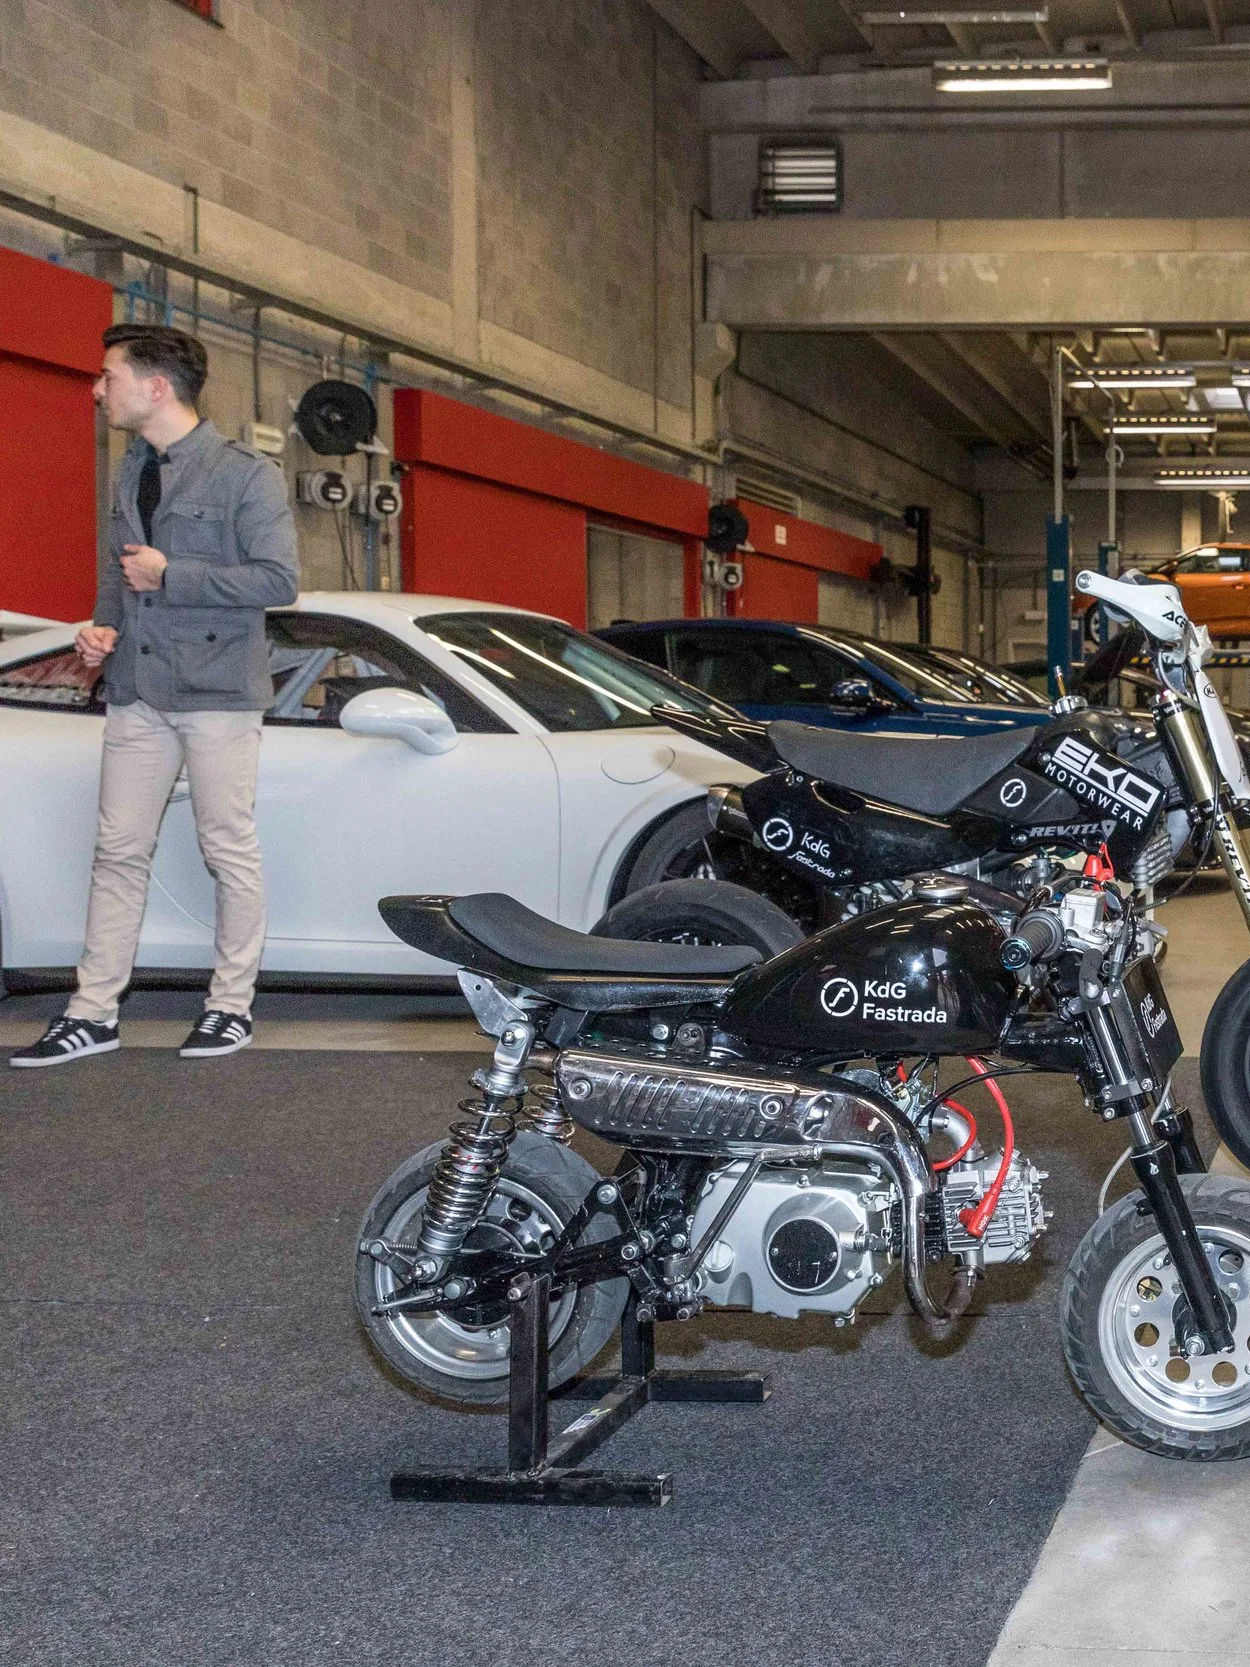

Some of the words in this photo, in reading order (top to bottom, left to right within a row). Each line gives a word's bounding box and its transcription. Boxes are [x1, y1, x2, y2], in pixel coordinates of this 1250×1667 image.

[1053, 736, 1160, 813] EKO
[1045, 762, 1143, 830] MOTORWEAR
[1029, 823, 1098, 837] REV'IT!
[801, 832, 830, 858] KdG
[864, 980, 906, 999] KdG
[863, 1003, 947, 1023] Fastrada
